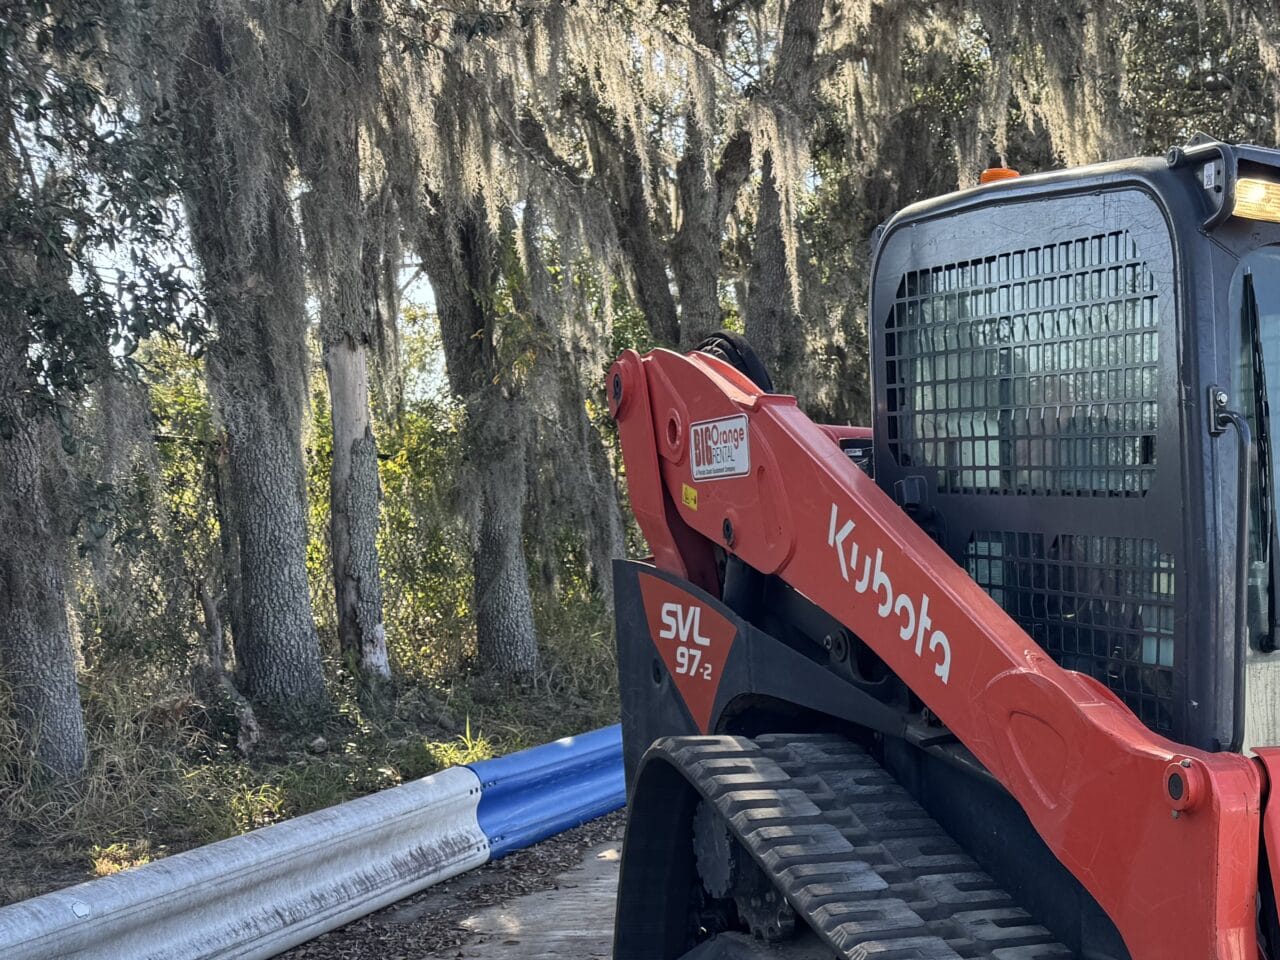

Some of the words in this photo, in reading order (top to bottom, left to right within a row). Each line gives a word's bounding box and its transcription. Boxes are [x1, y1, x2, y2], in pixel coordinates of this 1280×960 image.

[693, 426, 713, 467] BIG
[711, 424, 745, 450] Orange
[827, 503, 951, 685] Kubota
[659, 602, 711, 647] SVL
